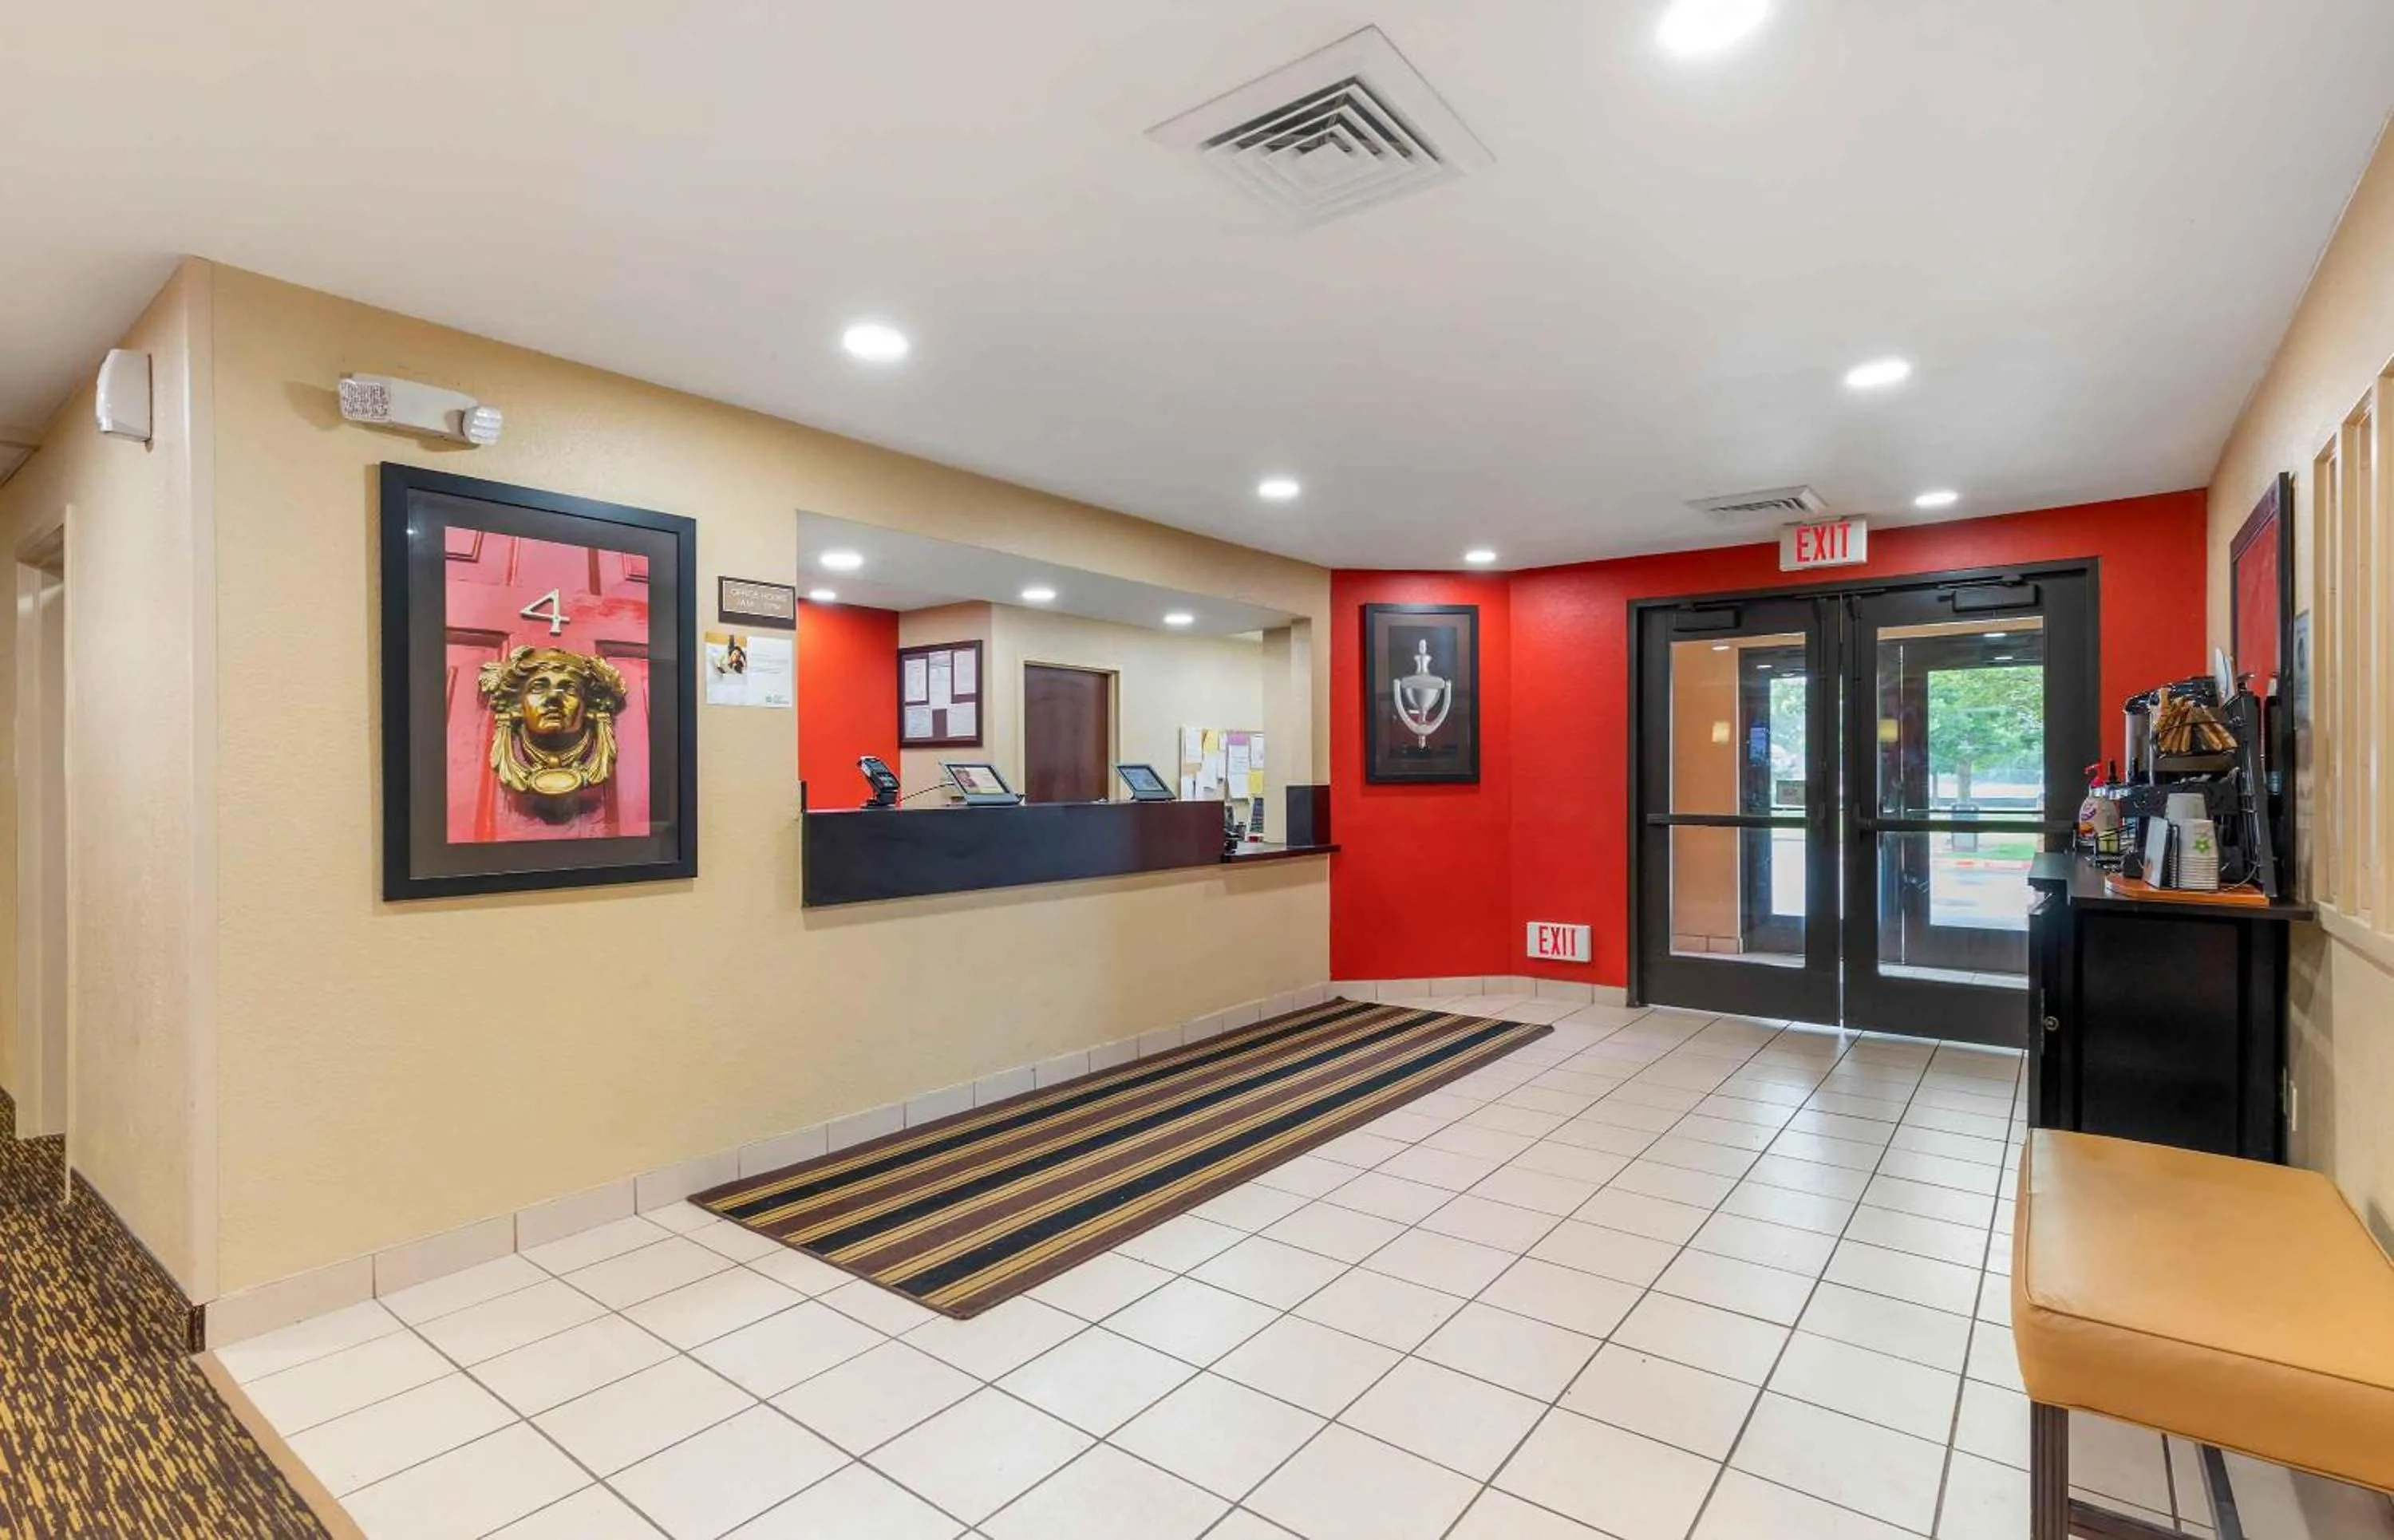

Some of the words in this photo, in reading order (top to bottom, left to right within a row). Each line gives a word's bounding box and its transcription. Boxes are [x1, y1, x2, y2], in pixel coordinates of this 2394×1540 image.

[1796, 520, 1851, 563] EXIT
[519, 587, 571, 637] 4
[1538, 925, 1577, 957] EXIT
